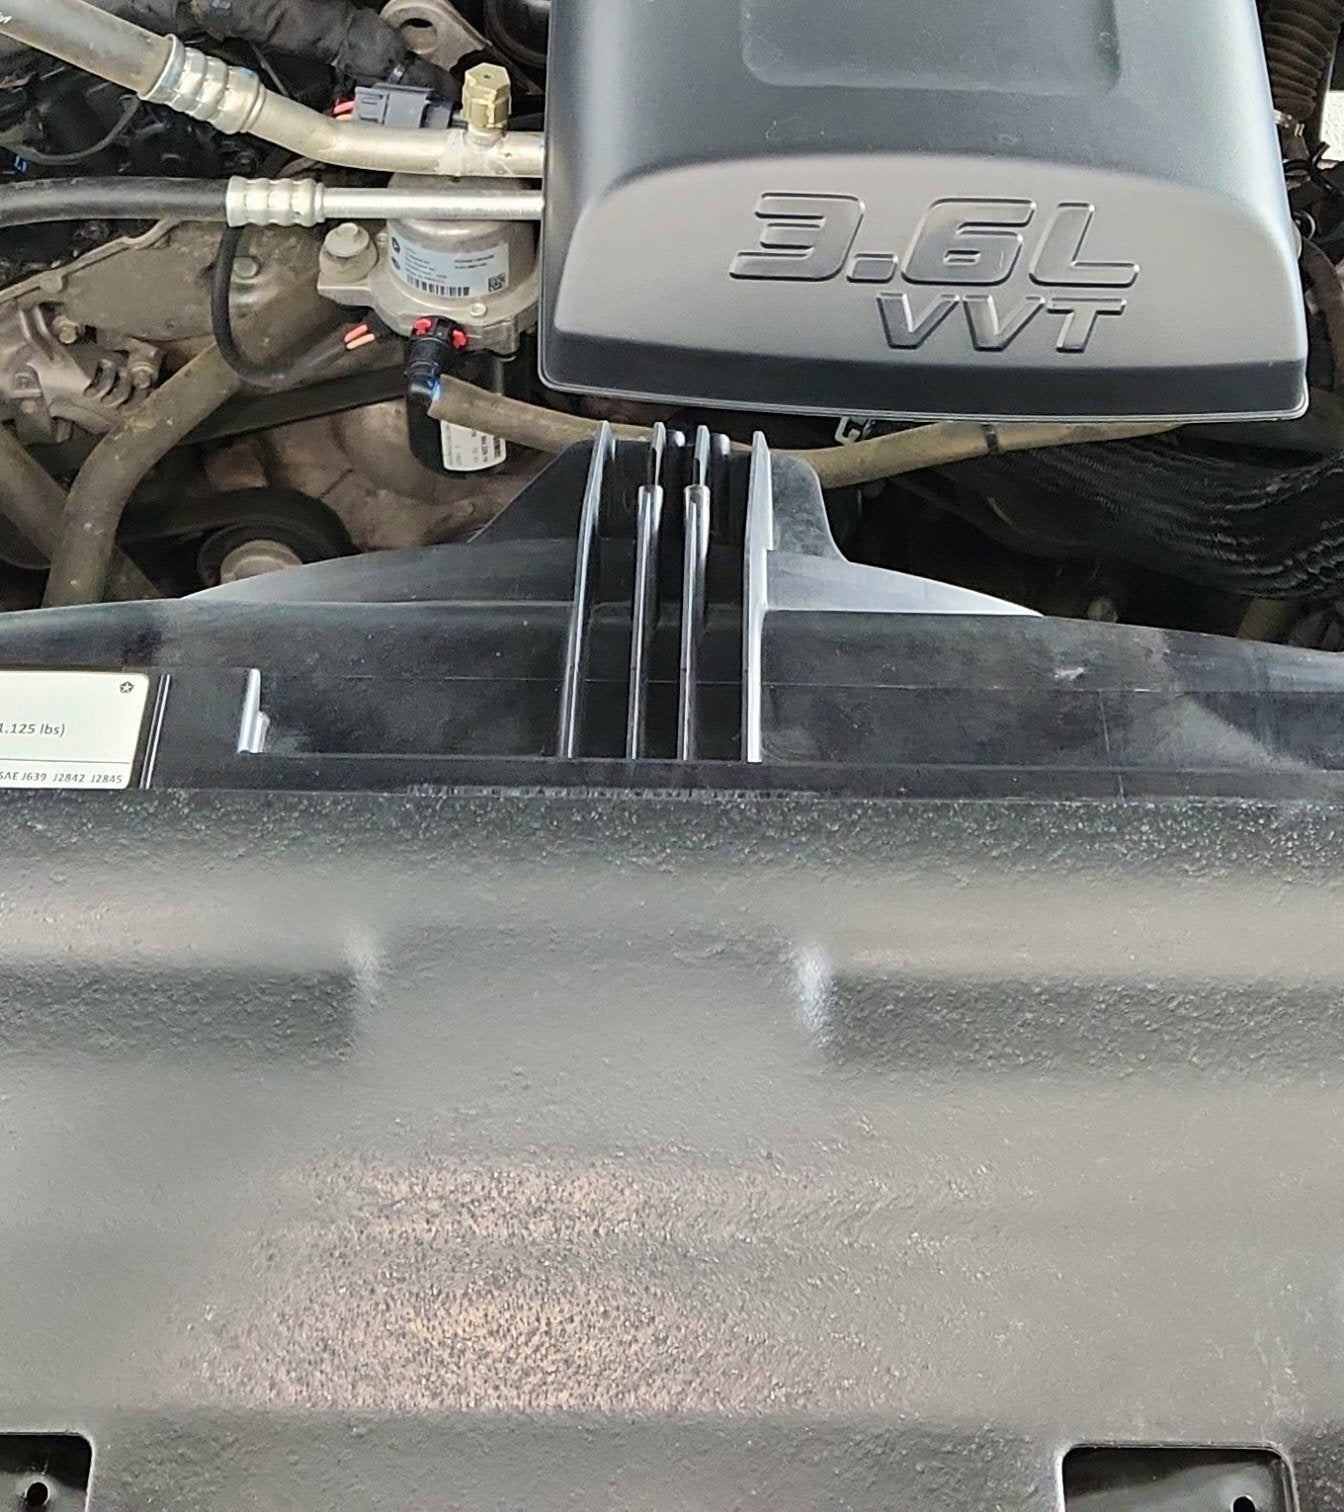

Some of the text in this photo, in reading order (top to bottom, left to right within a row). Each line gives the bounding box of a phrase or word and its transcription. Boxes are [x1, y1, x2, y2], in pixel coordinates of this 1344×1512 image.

[728, 191, 1140, 289] 3.6L
[875, 292, 1128, 354] VVT
[40, 723, 66, 738] lbs)
[21, 771, 47, 782] J639
[53, 772, 85, 784] J2842
